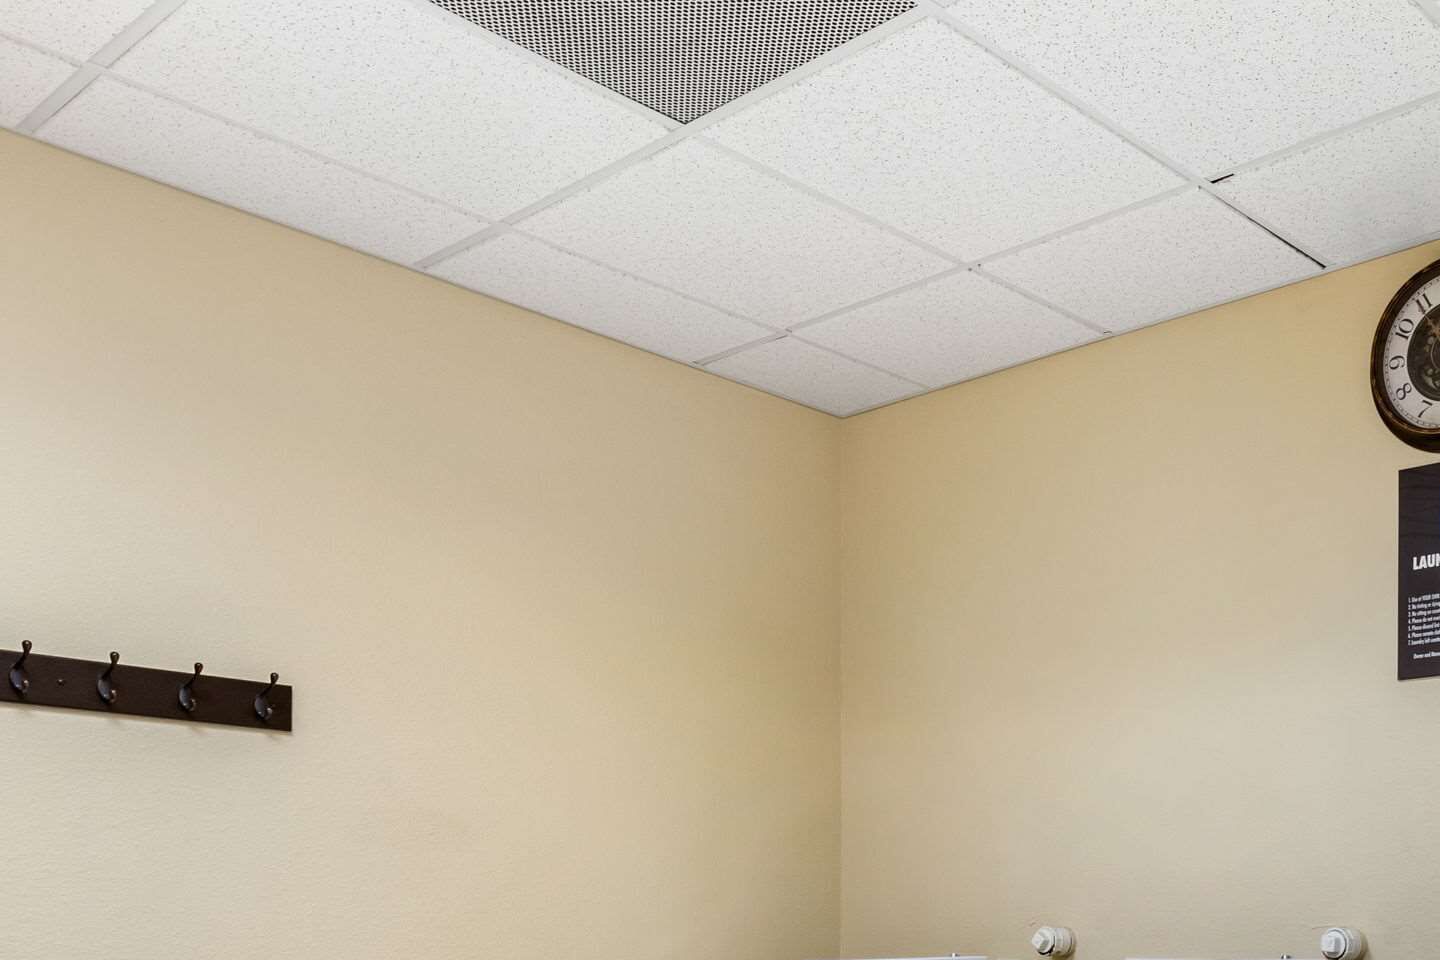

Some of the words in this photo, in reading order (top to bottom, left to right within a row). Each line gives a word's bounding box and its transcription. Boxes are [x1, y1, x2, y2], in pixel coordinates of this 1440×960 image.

[1416, 294, 1432, 314] 11
[1396, 318, 1414, 340] 10
[1389, 355, 1405, 370] 9
[1396, 382, 1412, 400] 8
[1417, 400, 1432, 418] 7
